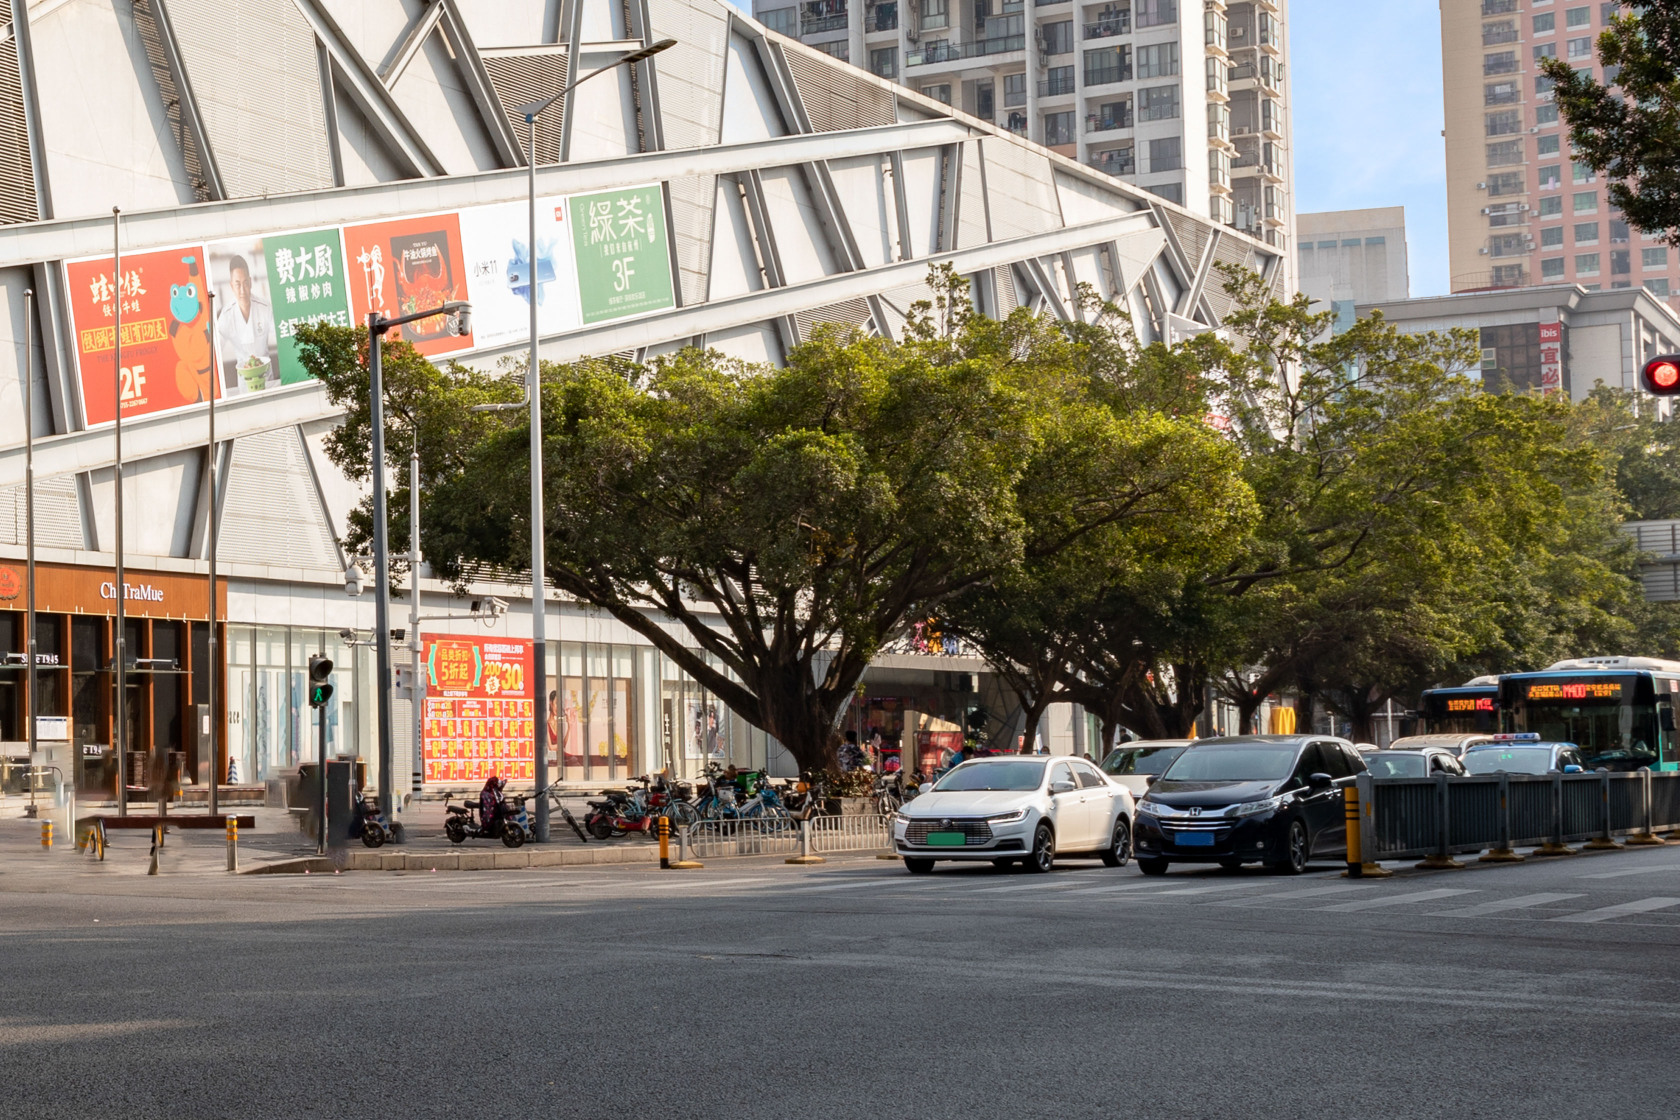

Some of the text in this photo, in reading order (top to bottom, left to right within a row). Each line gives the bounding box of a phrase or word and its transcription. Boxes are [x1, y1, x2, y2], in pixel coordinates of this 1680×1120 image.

[275, 243, 334, 285] 费大厨
[612, 256, 635, 292] 3F
[285, 281, 333, 304] 辣椒炒肉
[1540, 329, 1558, 338] ibis
[119, 364, 147, 401] 2F
[100, 581, 164, 602] ChTraMue
[441, 661, 469, 681] 5折起
